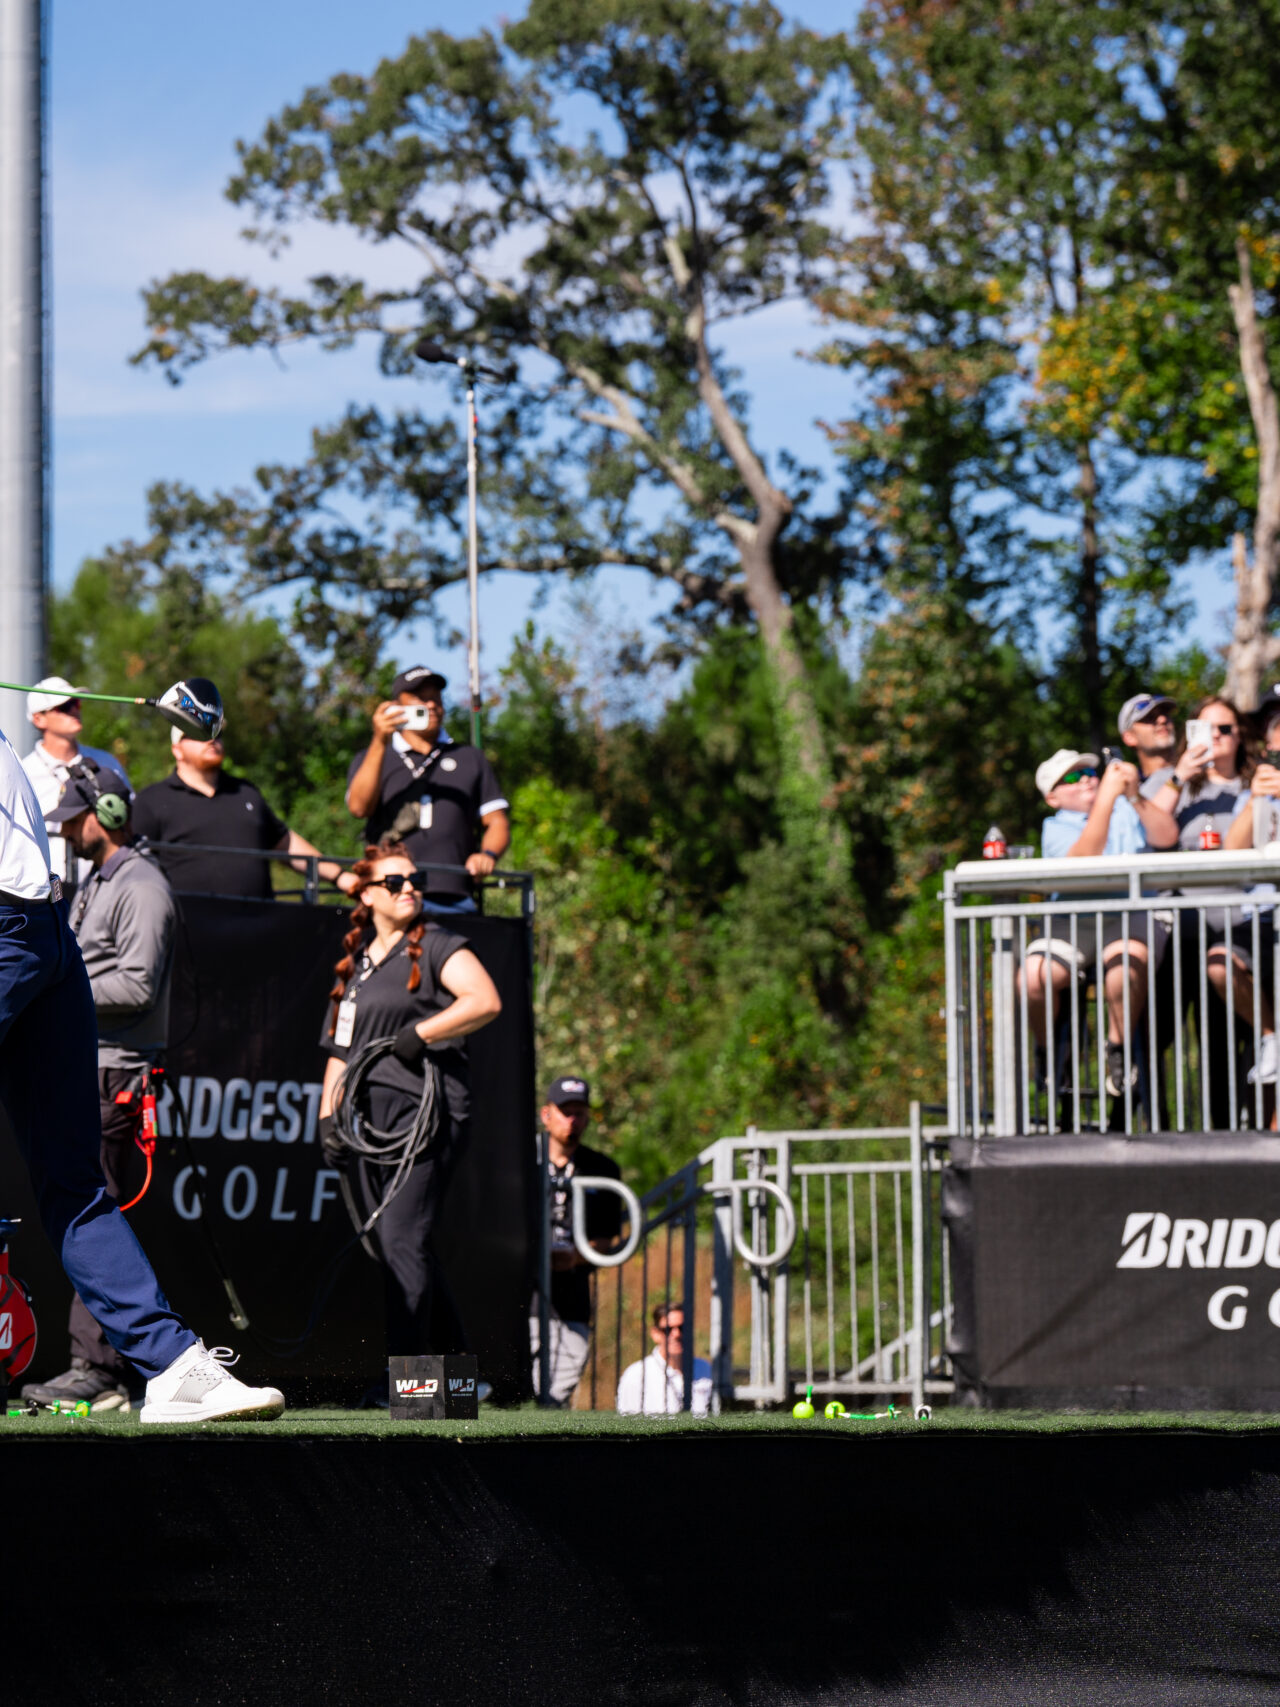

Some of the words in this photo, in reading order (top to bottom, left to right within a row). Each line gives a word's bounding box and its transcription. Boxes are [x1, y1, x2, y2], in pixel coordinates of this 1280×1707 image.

[156, 1075, 324, 1144] RIDGEST
[172, 1164, 341, 1222] GOLF
[1207, 1284, 1280, 1331] G
[396, 1379, 439, 1393] WLD
[448, 1378, 475, 1392] WLD
